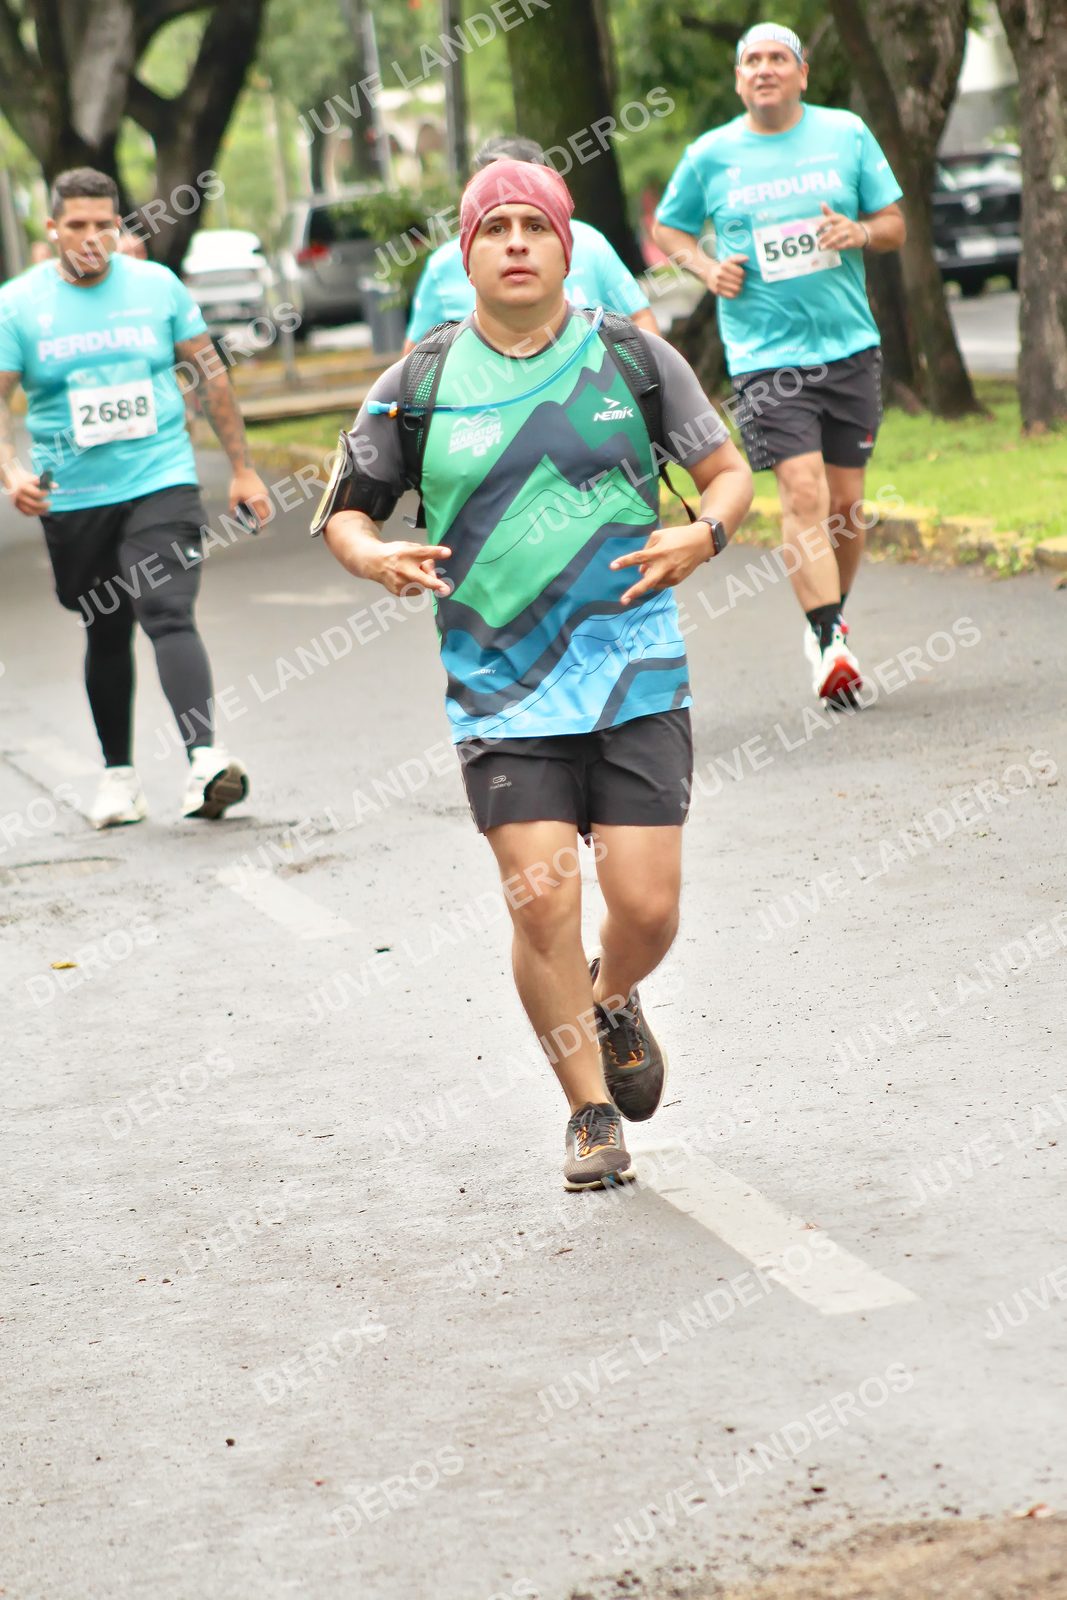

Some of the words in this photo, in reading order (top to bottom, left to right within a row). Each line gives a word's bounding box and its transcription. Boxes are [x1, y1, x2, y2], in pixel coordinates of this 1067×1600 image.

[727, 169, 842, 208] PERDURA
[763, 230, 824, 262] 569
[38, 326, 157, 362] PERDURA
[79, 396, 149, 426] 2688
